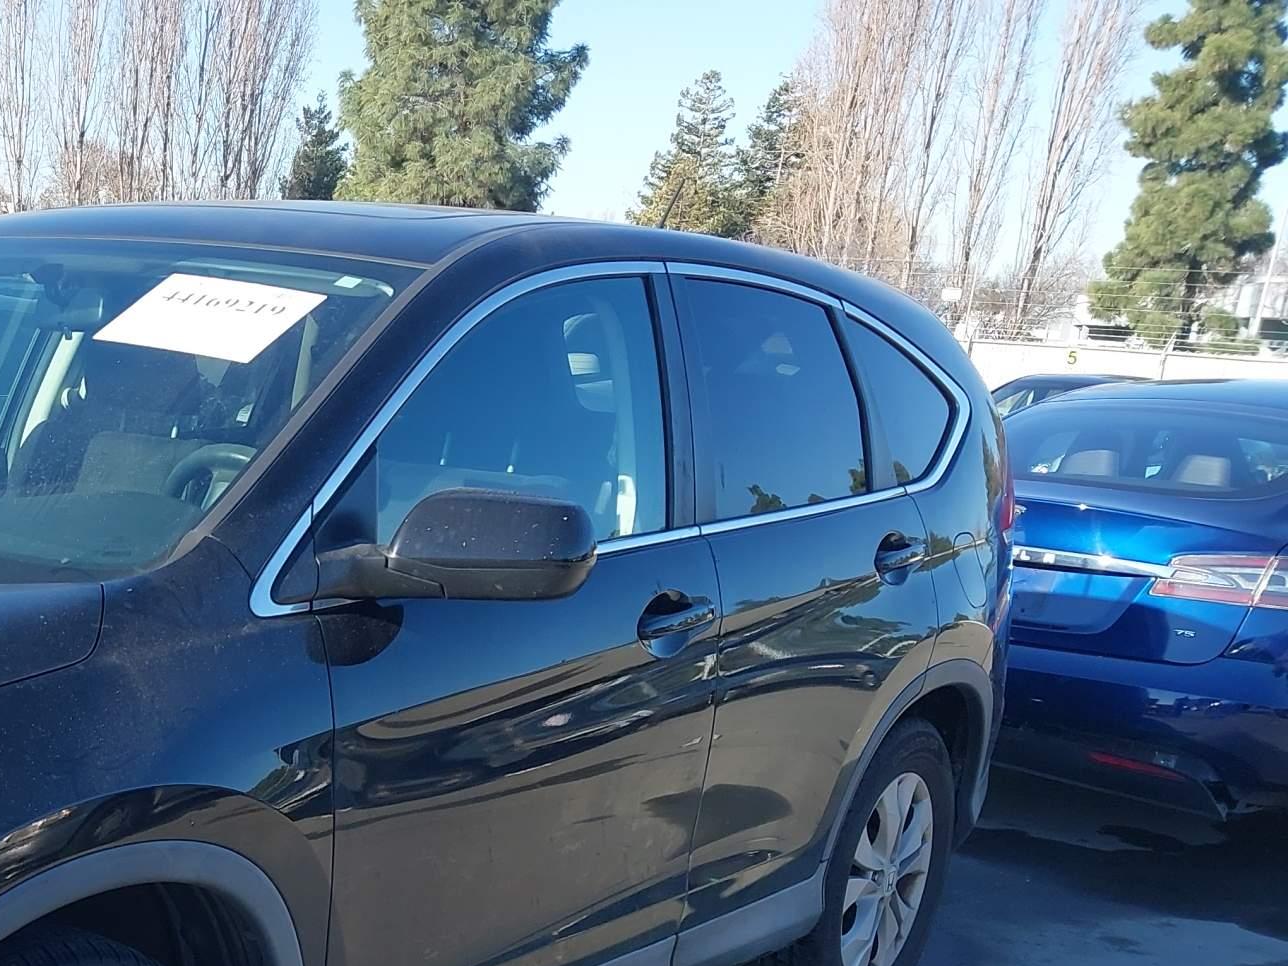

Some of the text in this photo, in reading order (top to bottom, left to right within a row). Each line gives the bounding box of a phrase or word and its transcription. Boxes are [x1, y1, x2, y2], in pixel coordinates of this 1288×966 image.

[162, 290, 286, 316] 44169219
[1067, 350, 1077, 365] 5
[1173, 629, 1196, 638] 75
